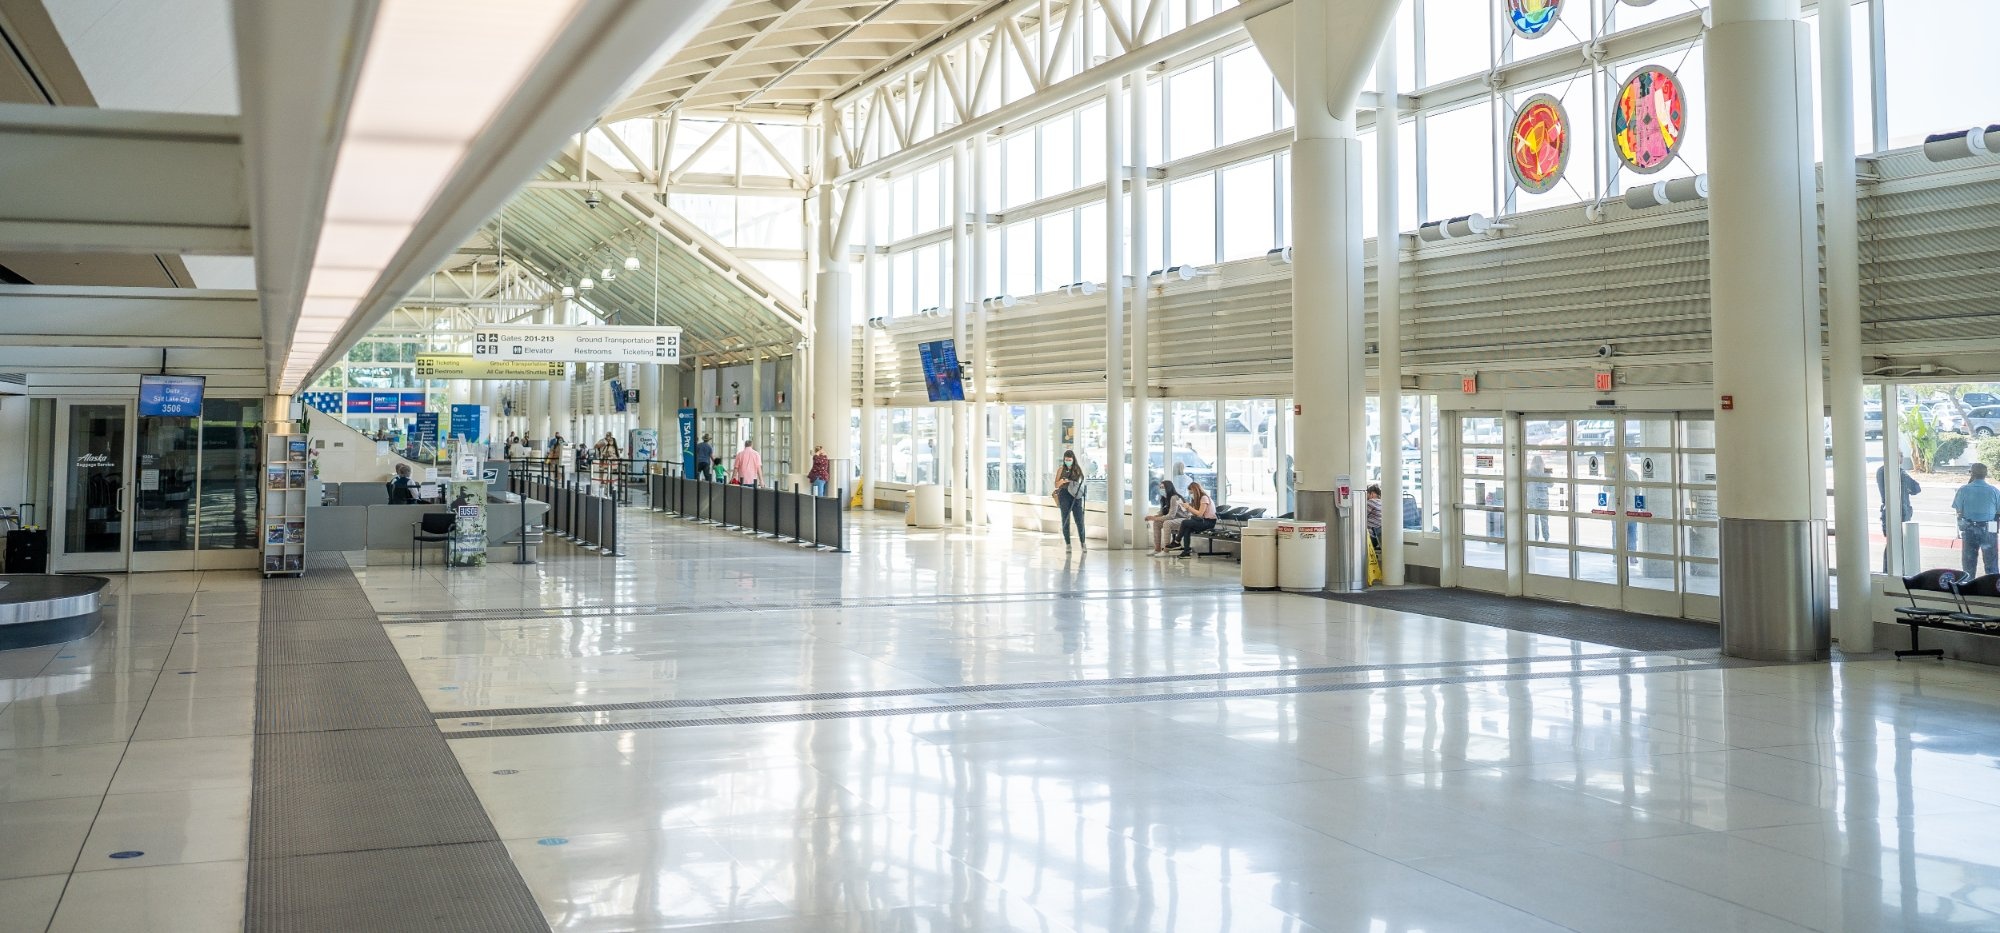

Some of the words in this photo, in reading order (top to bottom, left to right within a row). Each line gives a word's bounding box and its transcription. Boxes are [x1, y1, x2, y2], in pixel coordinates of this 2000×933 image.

[605, 337, 655, 345] Transportation
[1464, 380, 1474, 392] EXIT
[1597, 375, 1609, 389] EXIT
[162, 404, 181, 413] 3506
[77, 453, 108, 462] Alaska
[463, 507, 475, 515] USO
